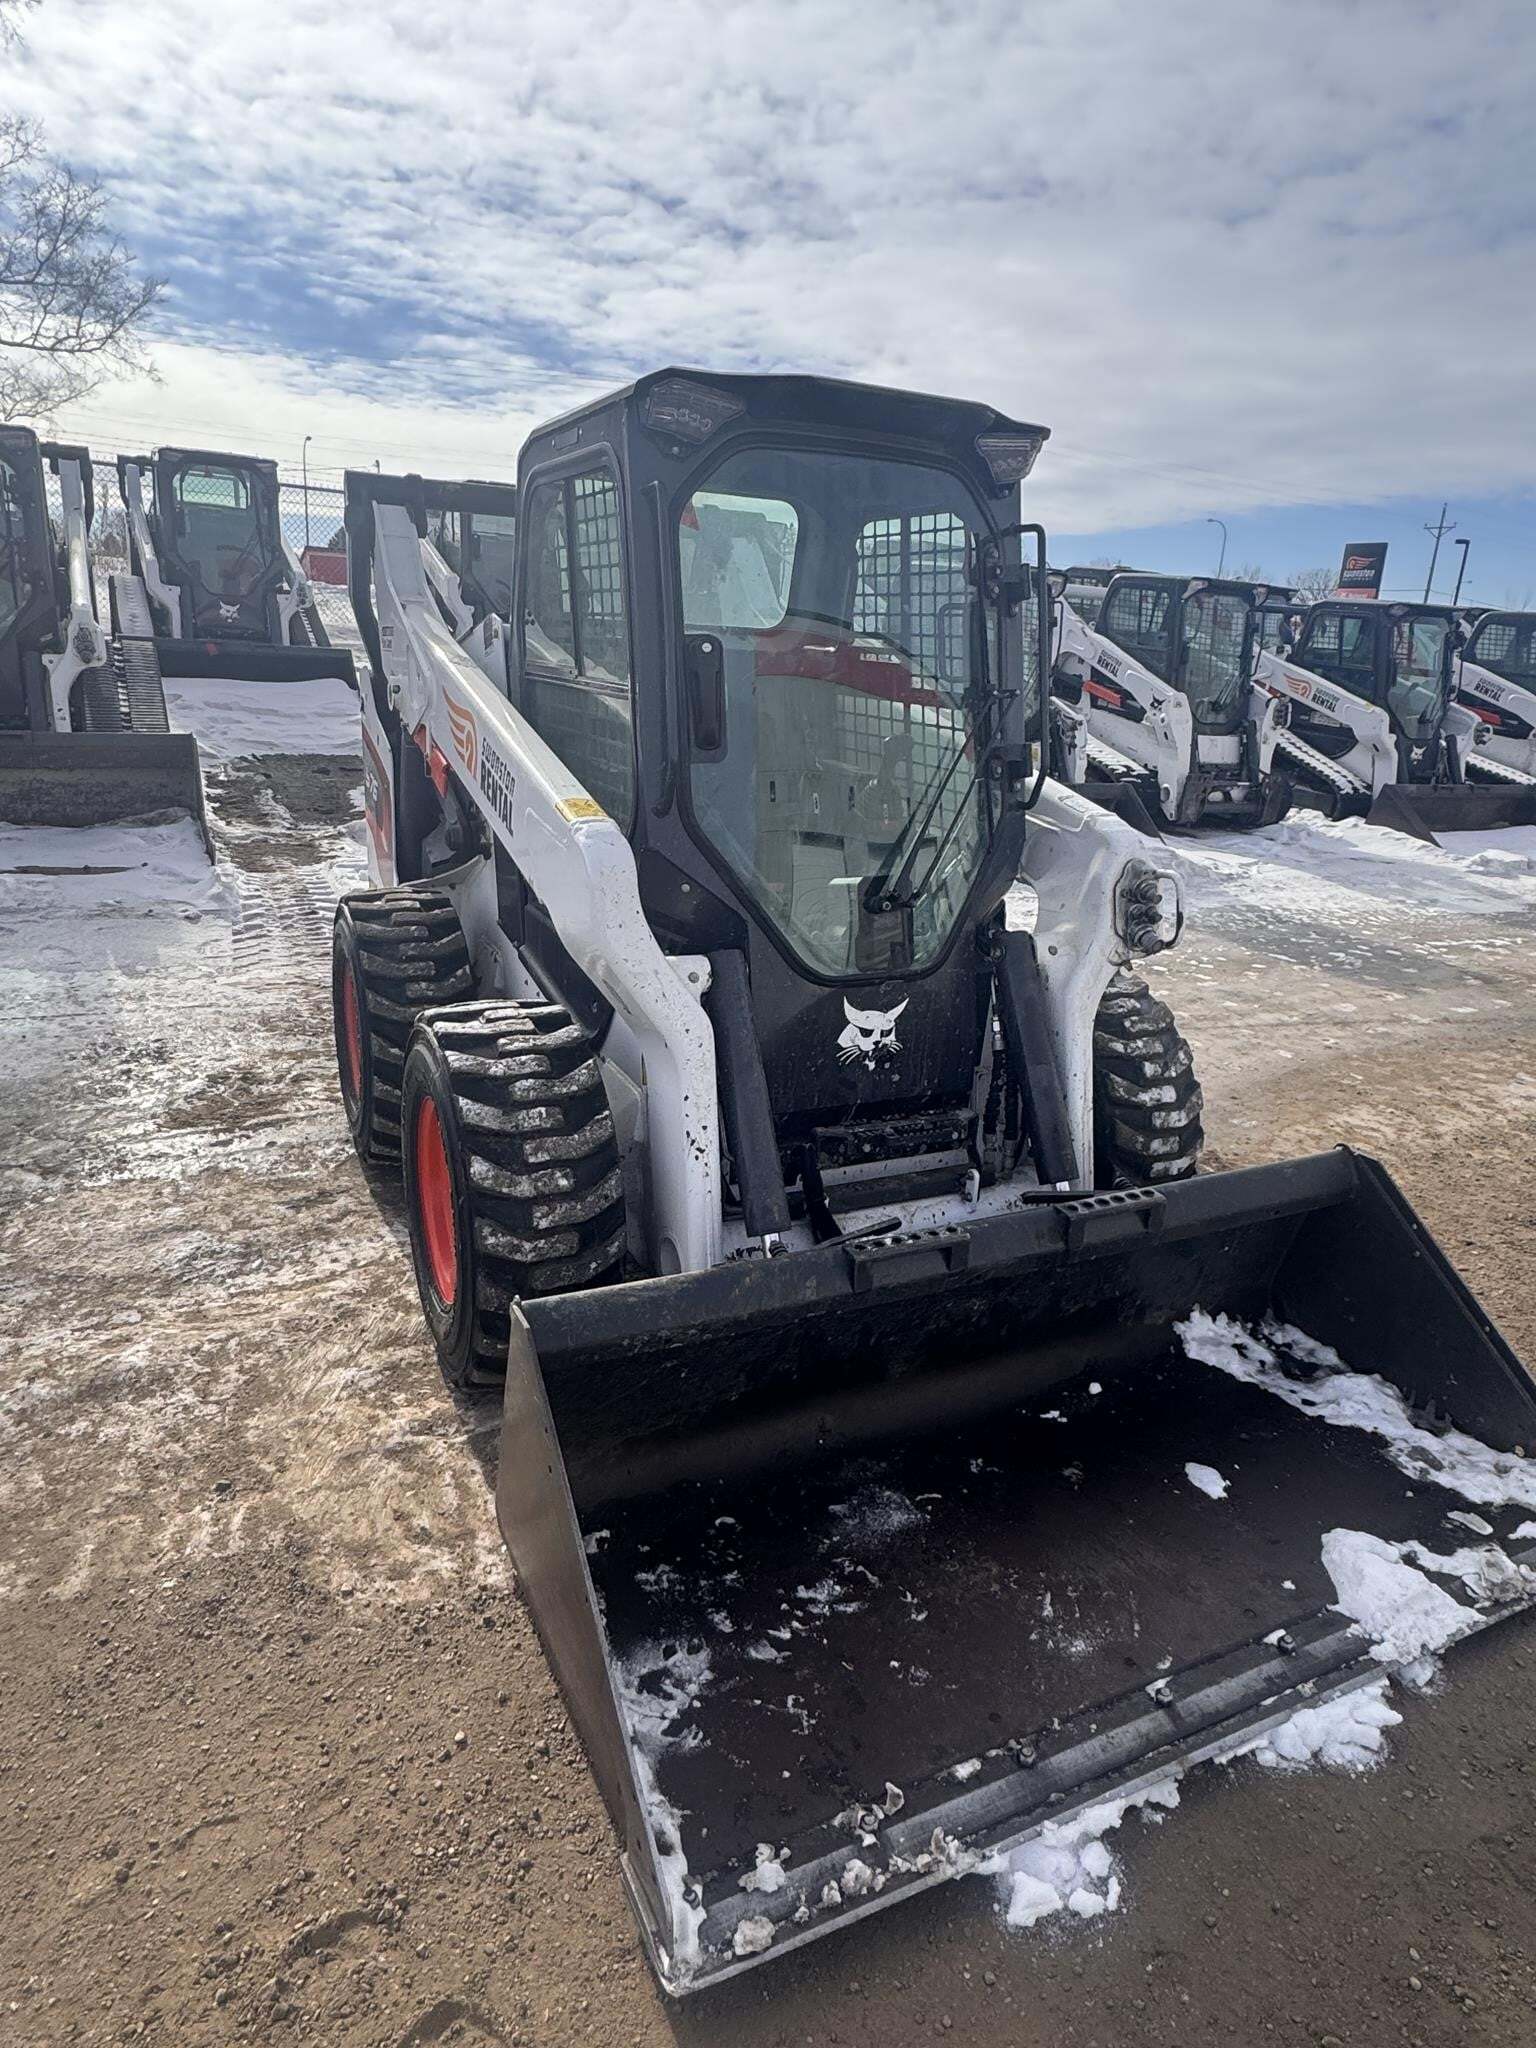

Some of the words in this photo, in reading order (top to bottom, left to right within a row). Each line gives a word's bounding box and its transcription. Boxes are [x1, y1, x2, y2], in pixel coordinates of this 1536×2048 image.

[1096, 655, 1119, 678] RENTAL
[1311, 692, 1337, 713] RENTAL
[1473, 681, 1502, 702] RENTAL
[480, 758, 514, 838] RENTAL
